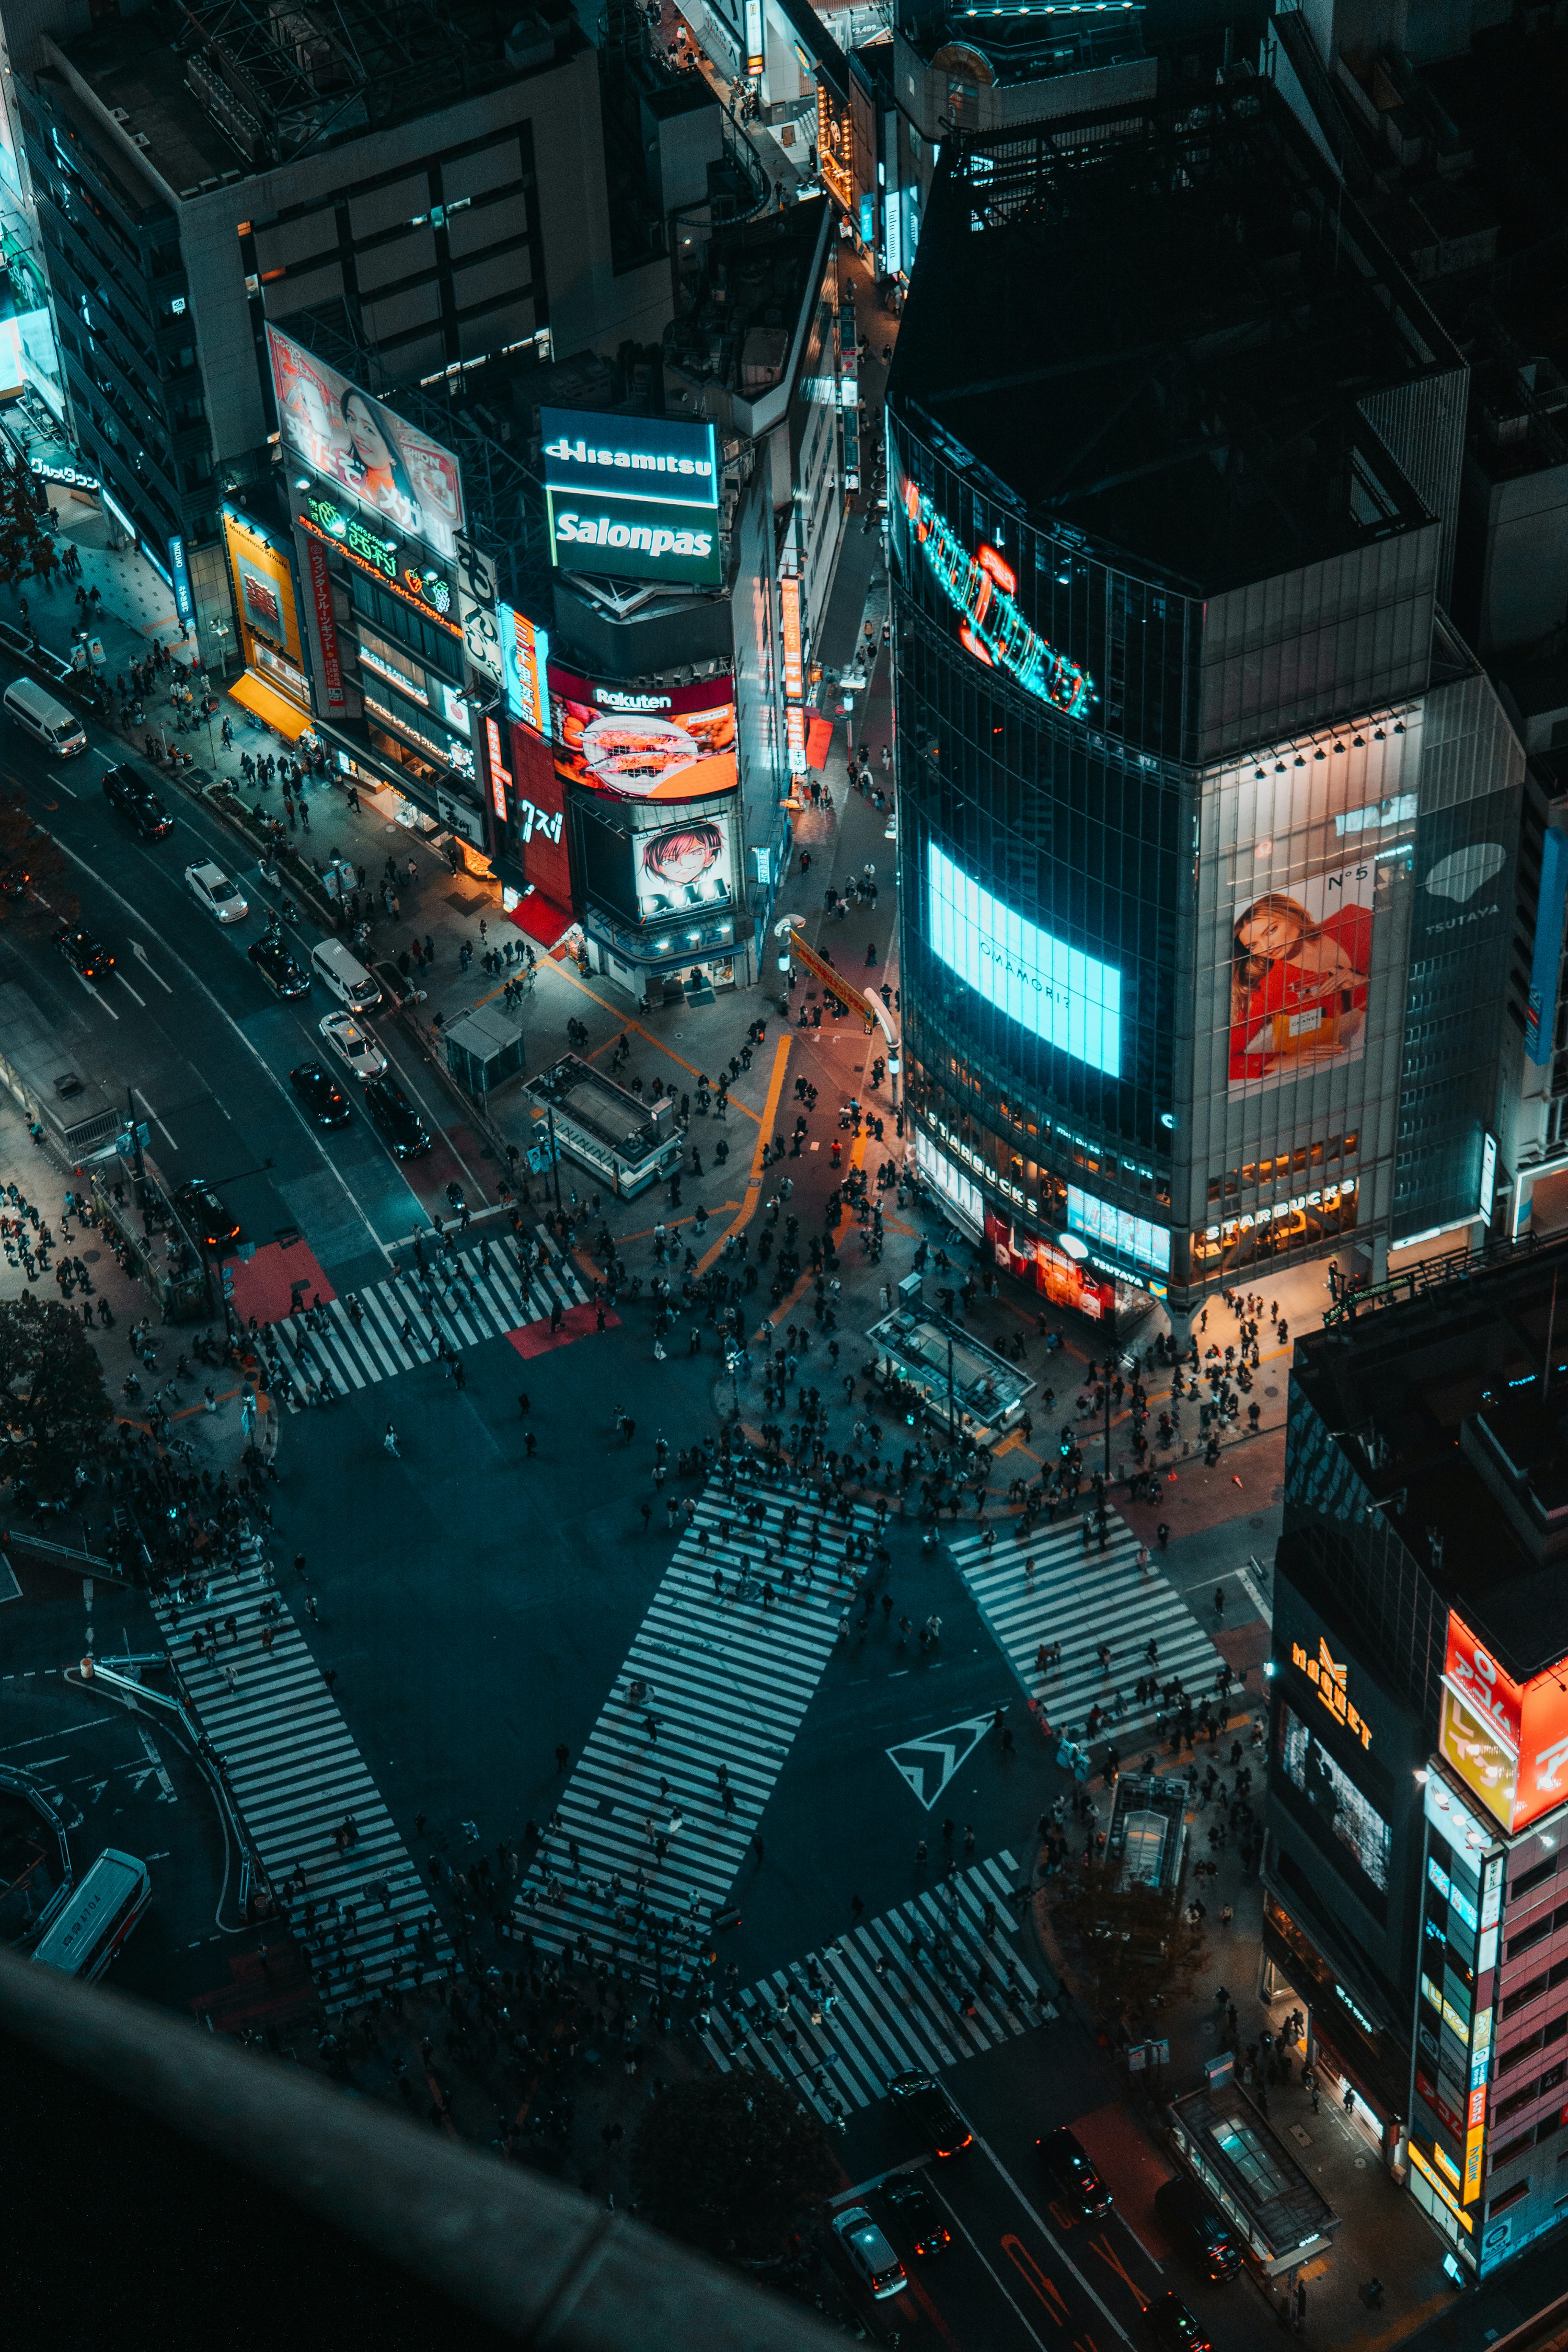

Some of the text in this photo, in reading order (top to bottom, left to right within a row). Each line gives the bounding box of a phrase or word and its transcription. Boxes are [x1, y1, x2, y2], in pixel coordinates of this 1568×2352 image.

[31, 457, 98, 489] グルメタウン
[545, 439, 712, 476] Hisamitsu
[173, 541, 183, 568] MIZUHO
[229, 523, 264, 552] Matsumoto
[556, 513, 712, 557] Salonpas
[178, 585, 189, 613] みずほ銀行
[244, 572, 279, 621] 薬
[312, 555, 335, 651] ウィンターフルーツギフト
[515, 621, 537, 727] 三千里薬品
[595, 688, 673, 710] Rakuten
[1425, 904, 1500, 936] TSUTAYA
[981, 942, 1069, 1009] OMAMORI?
[928, 1112, 1038, 1213] STARBUCKS
[1205, 1179, 1355, 1241] STARBUCKS
[1091, 1256, 1145, 1288] TSUTAYA
[1429, 1984, 1468, 2035] レイク
[1467, 2143, 1481, 2184] プロミス
[1421, 2159, 1459, 2213] プロミス
